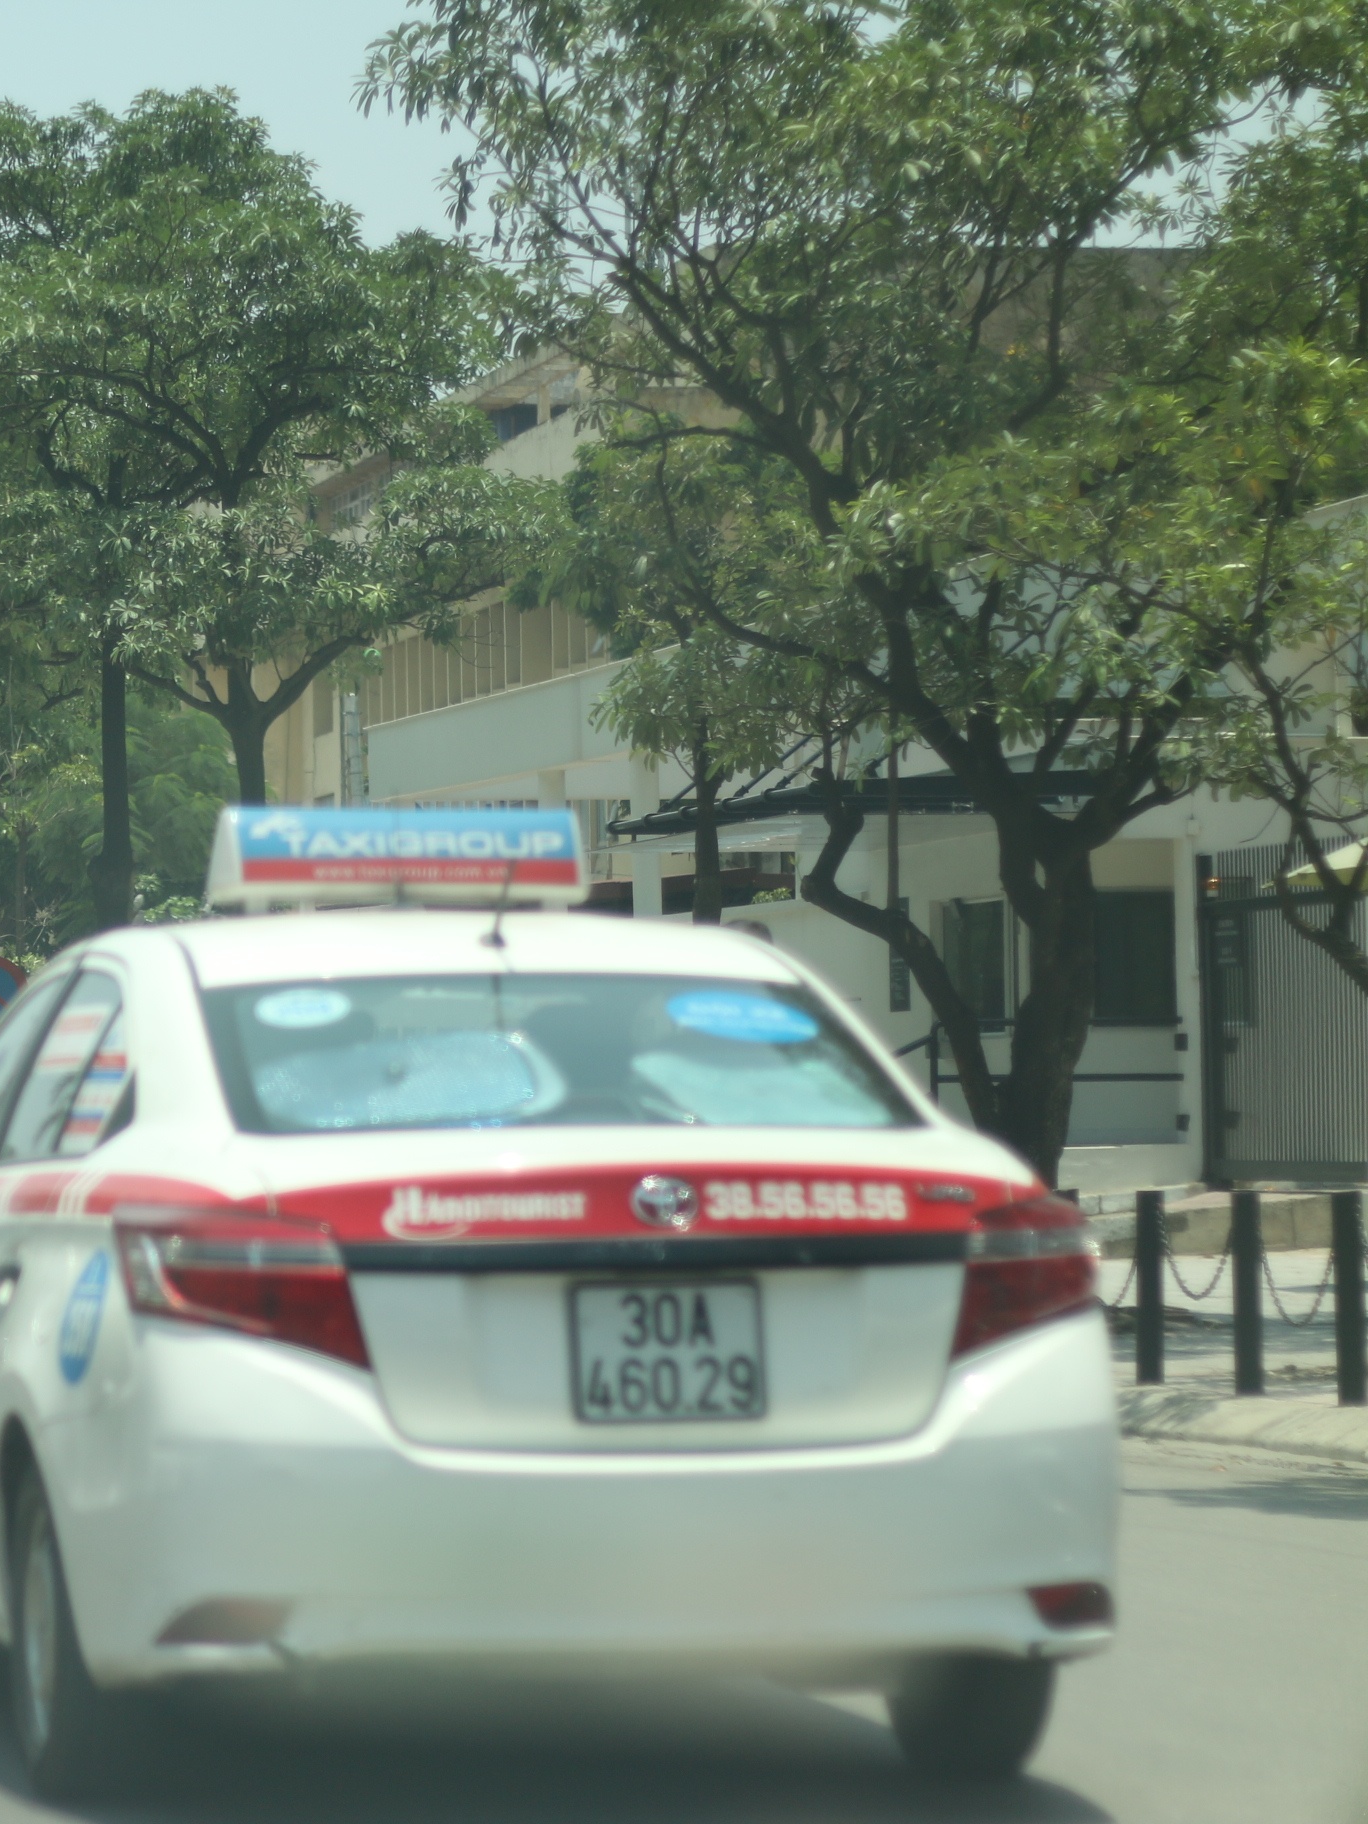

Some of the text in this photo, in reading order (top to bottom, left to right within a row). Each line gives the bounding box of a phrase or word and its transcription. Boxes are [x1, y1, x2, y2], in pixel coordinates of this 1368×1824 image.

[284, 829, 564, 858] TAXIGROUP
[704, 1181, 908, 1221] 38.56.56.56
[621, 1294, 716, 1348] 30A
[586, 1356, 757, 1414] 460.29
